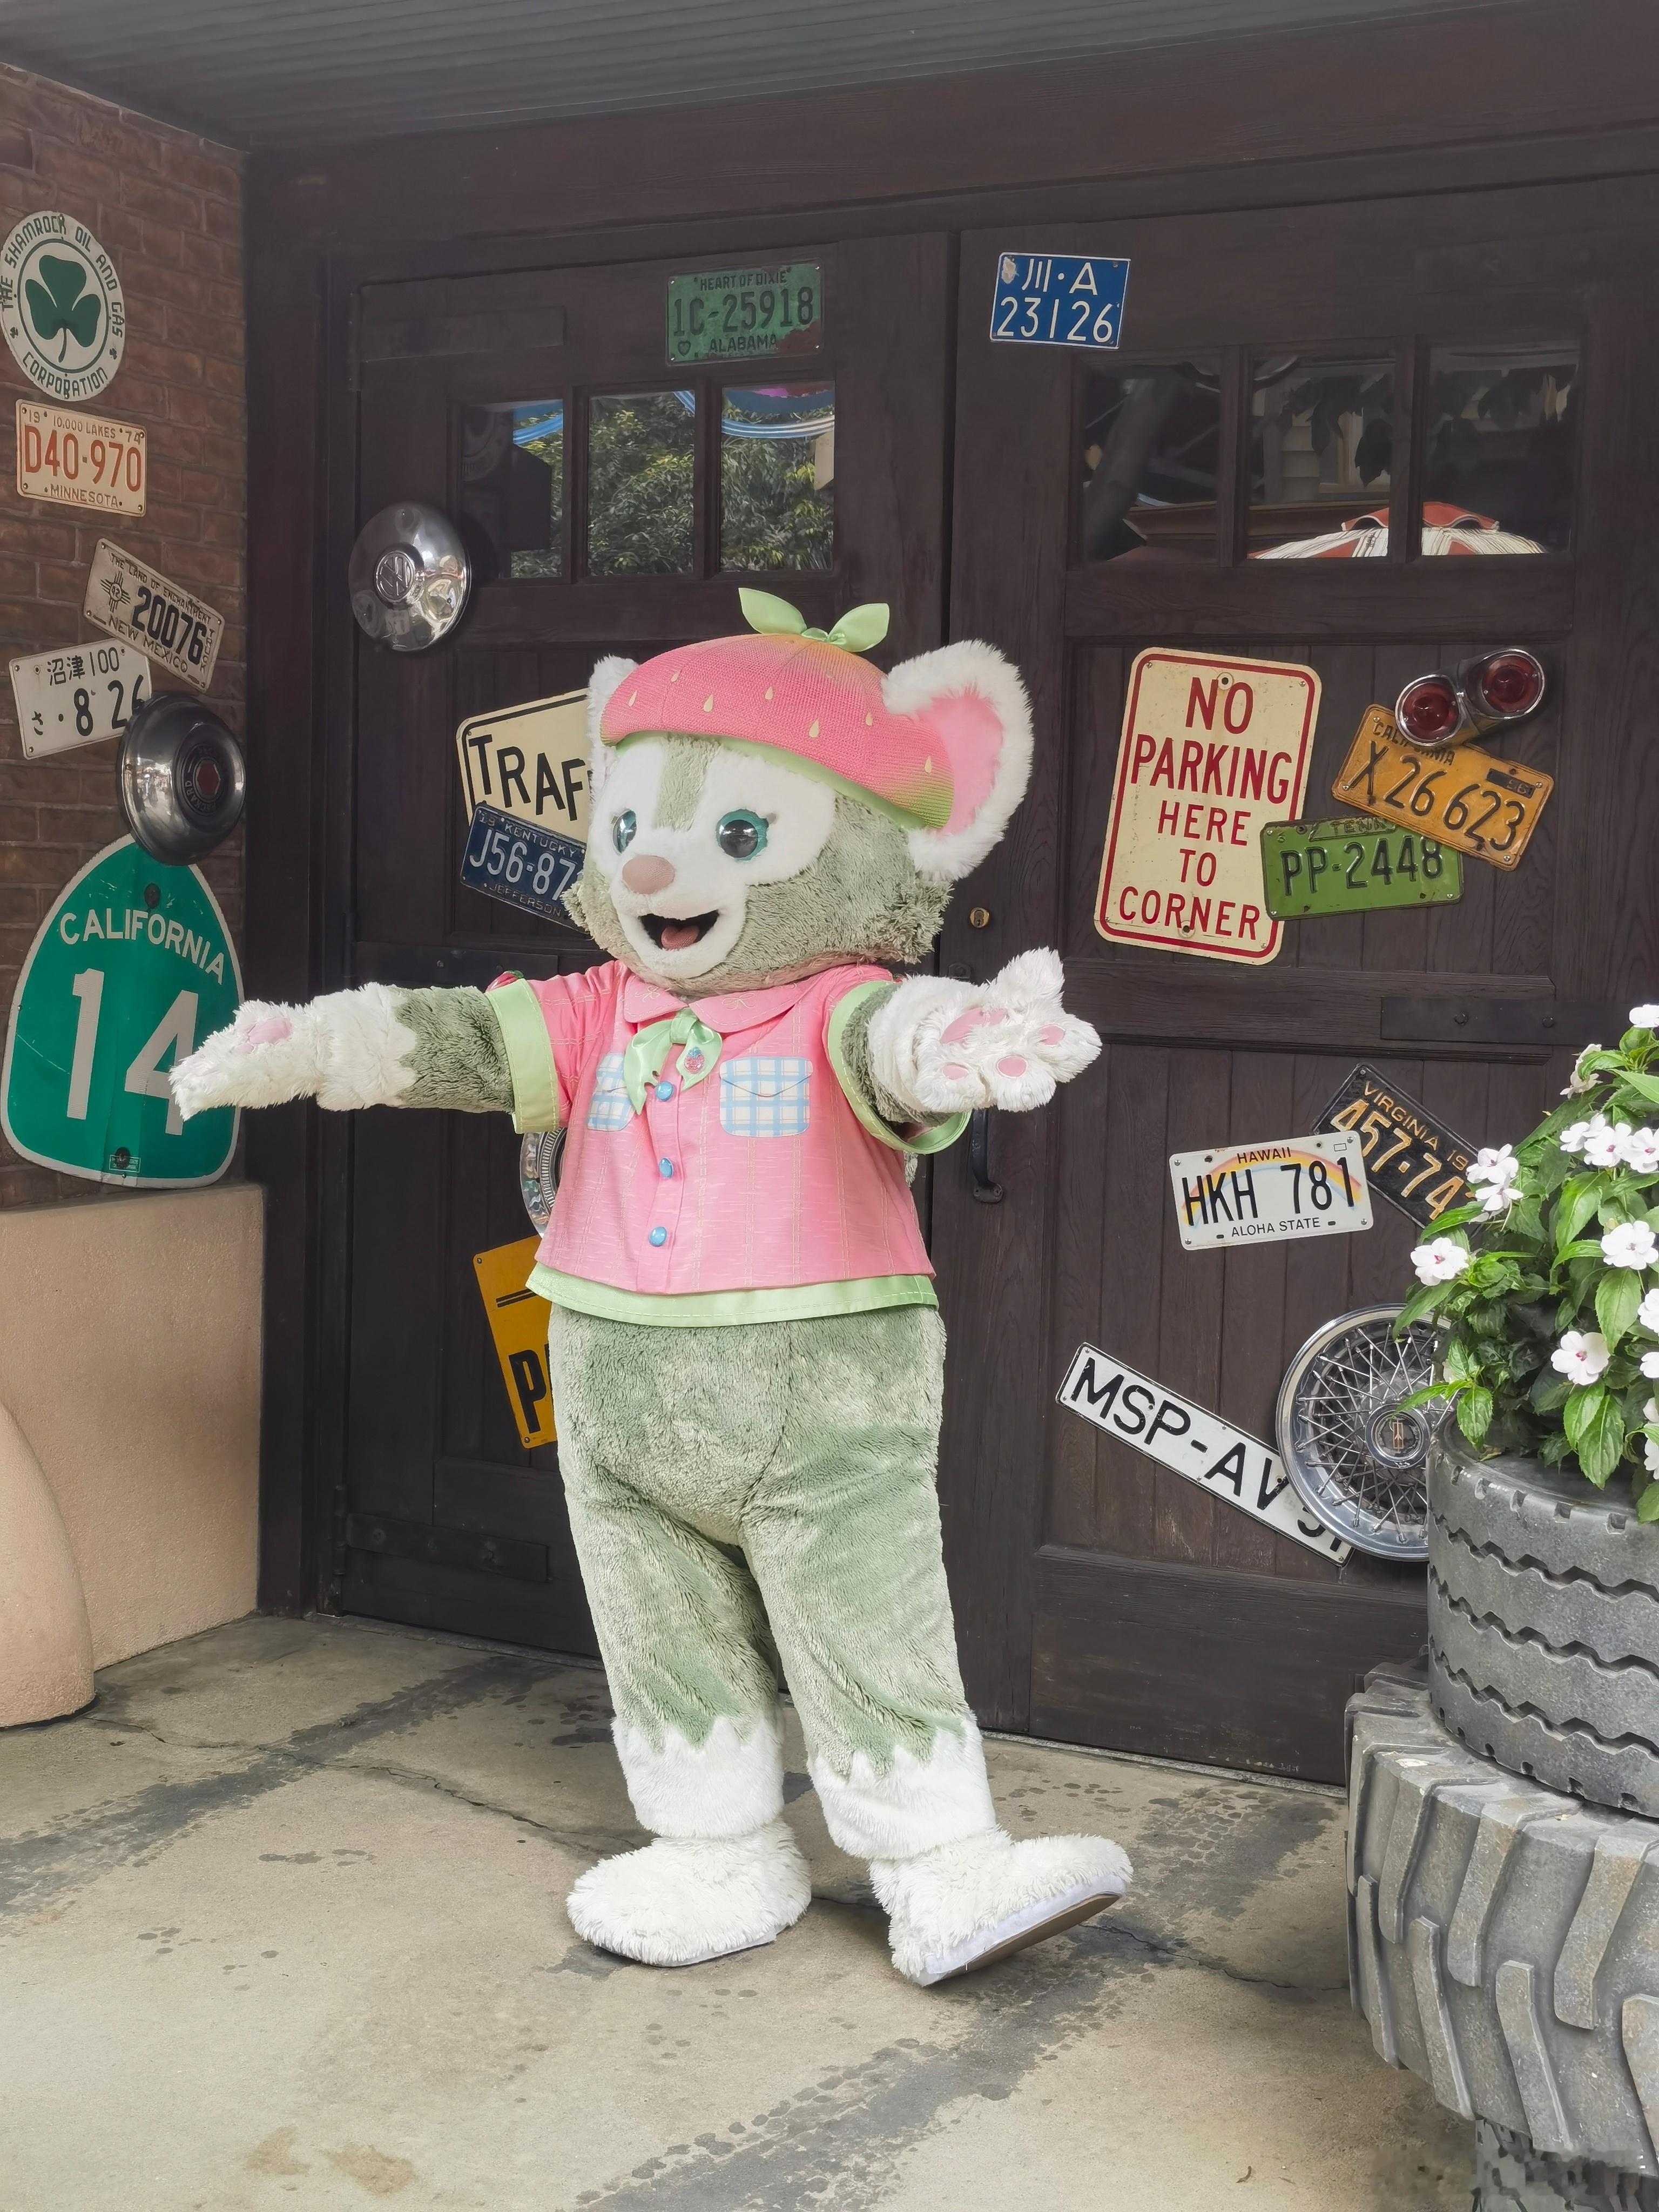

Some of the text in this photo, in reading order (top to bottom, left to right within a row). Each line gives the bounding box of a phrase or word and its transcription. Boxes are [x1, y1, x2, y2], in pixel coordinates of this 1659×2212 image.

[1, 214, 125, 338] THE SHAMROCK OIL AND GAS
[700, 271, 787, 291] HEART OF DIXIE
[997, 296, 1112, 342] 23126
[709, 334, 777, 352] ALABAMA
[22, 351, 108, 399] CORPORATION
[29, 411, 40, 423] 19
[86, 421, 116, 439] LAKES
[50, 483, 119, 508] MINNESOTA
[110, 553, 125, 570] THE
[128, 562, 147, 583] LAND
[151, 578, 160, 590] OF
[109, 615, 188, 673] NEW MEXICO
[131, 585, 207, 665] 20076
[200, 629, 215, 675] TRUCK
[32, 711, 43, 736] さ
[1185, 677, 1253, 734] NO
[468, 734, 592, 821] TRAF
[1130, 733, 1292, 804] PARKING
[505, 824, 576, 858] KENTUCKY
[1158, 800, 1251, 846] HERE
[1179, 848, 1217, 887] TO
[489, 884, 561, 916] JEFFERSON
[1119, 886, 1260, 941] CORNER
[60, 908, 226, 985] CALIFORNIA
[67, 968, 198, 1136] 14
[1364, 1081, 1438, 1151] VIRGINIA
[1237, 1147, 1291, 1164] HAWAII
[1182, 1156, 1355, 1226] HKH 781
[1231, 1217, 1320, 1237] ALOHA STATE
[509, 1344, 554, 1433] P
